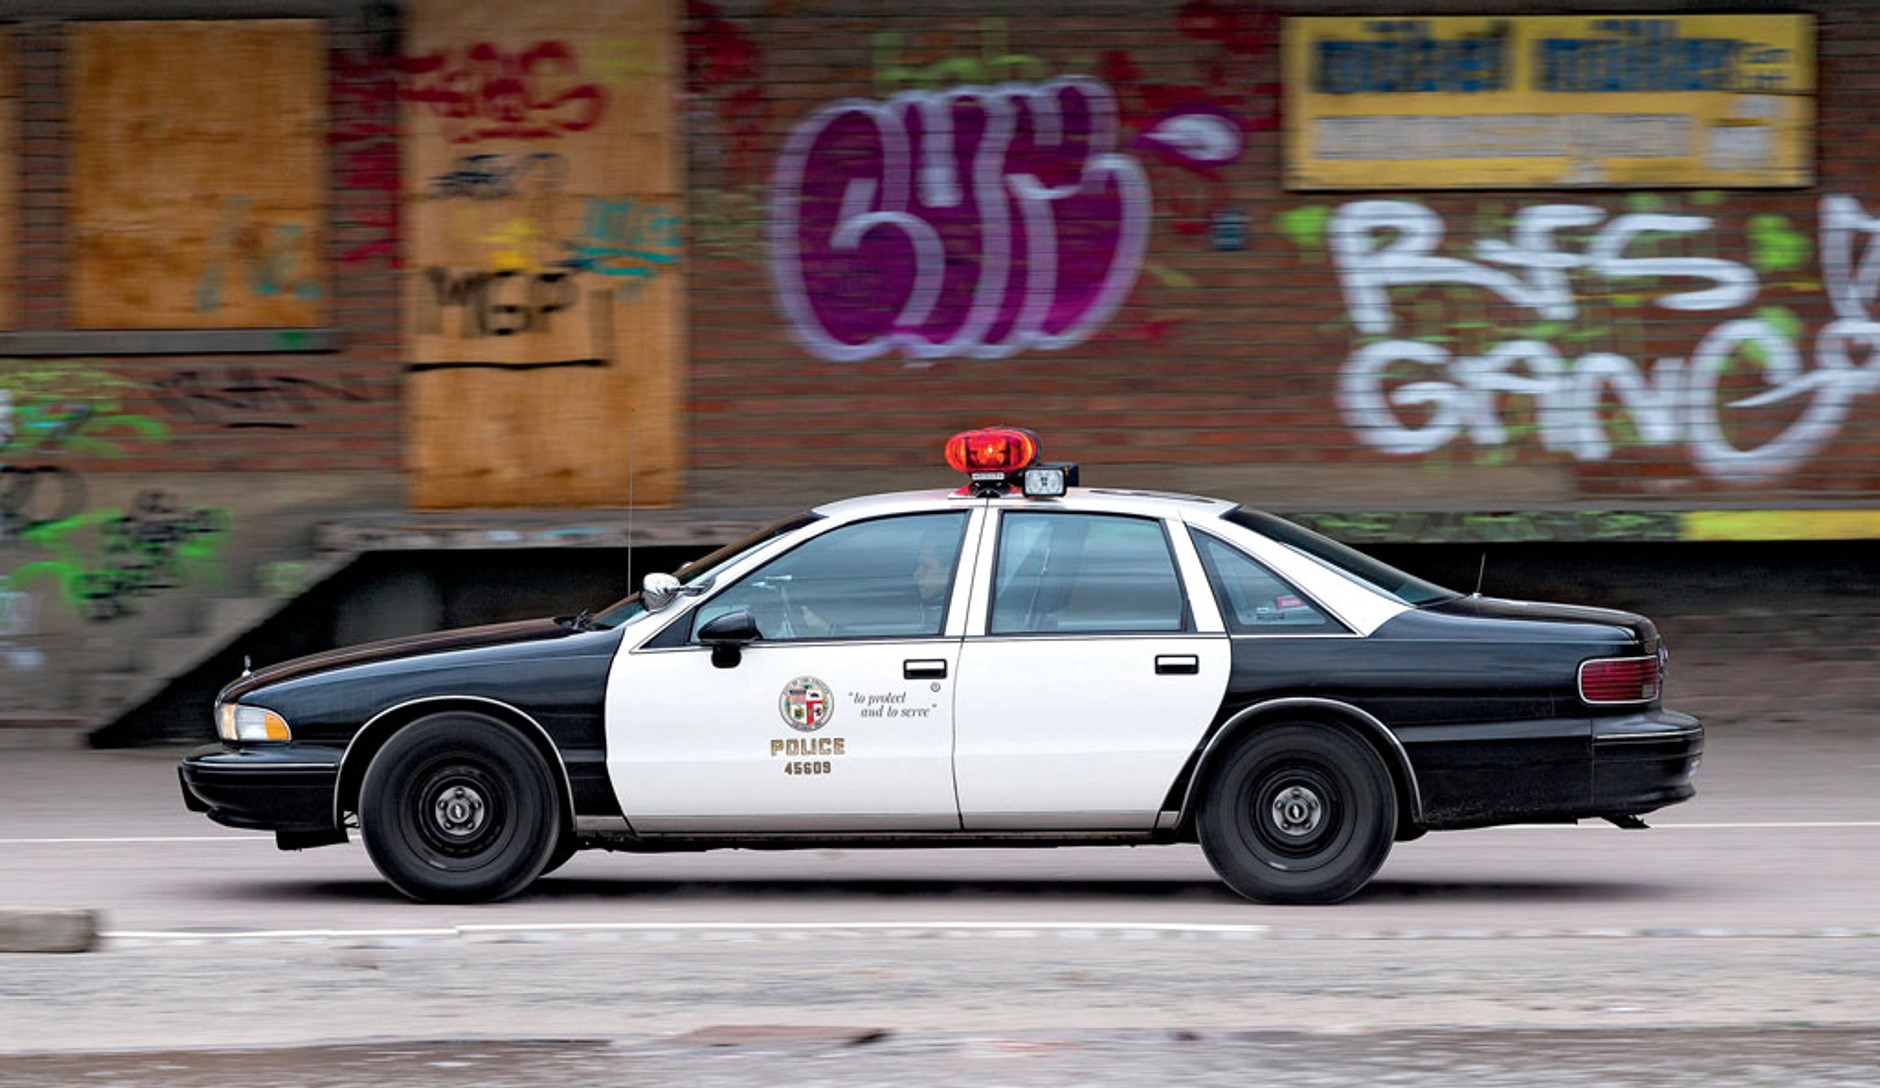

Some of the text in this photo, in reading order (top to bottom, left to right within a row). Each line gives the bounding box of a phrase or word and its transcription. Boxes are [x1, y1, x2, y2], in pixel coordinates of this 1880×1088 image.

[867, 691, 907, 706] protect
[860, 705, 884, 717] and
[886, 706, 899, 717] to
[770, 737, 846, 757] POLICE
[784, 761, 831, 775] 45609
